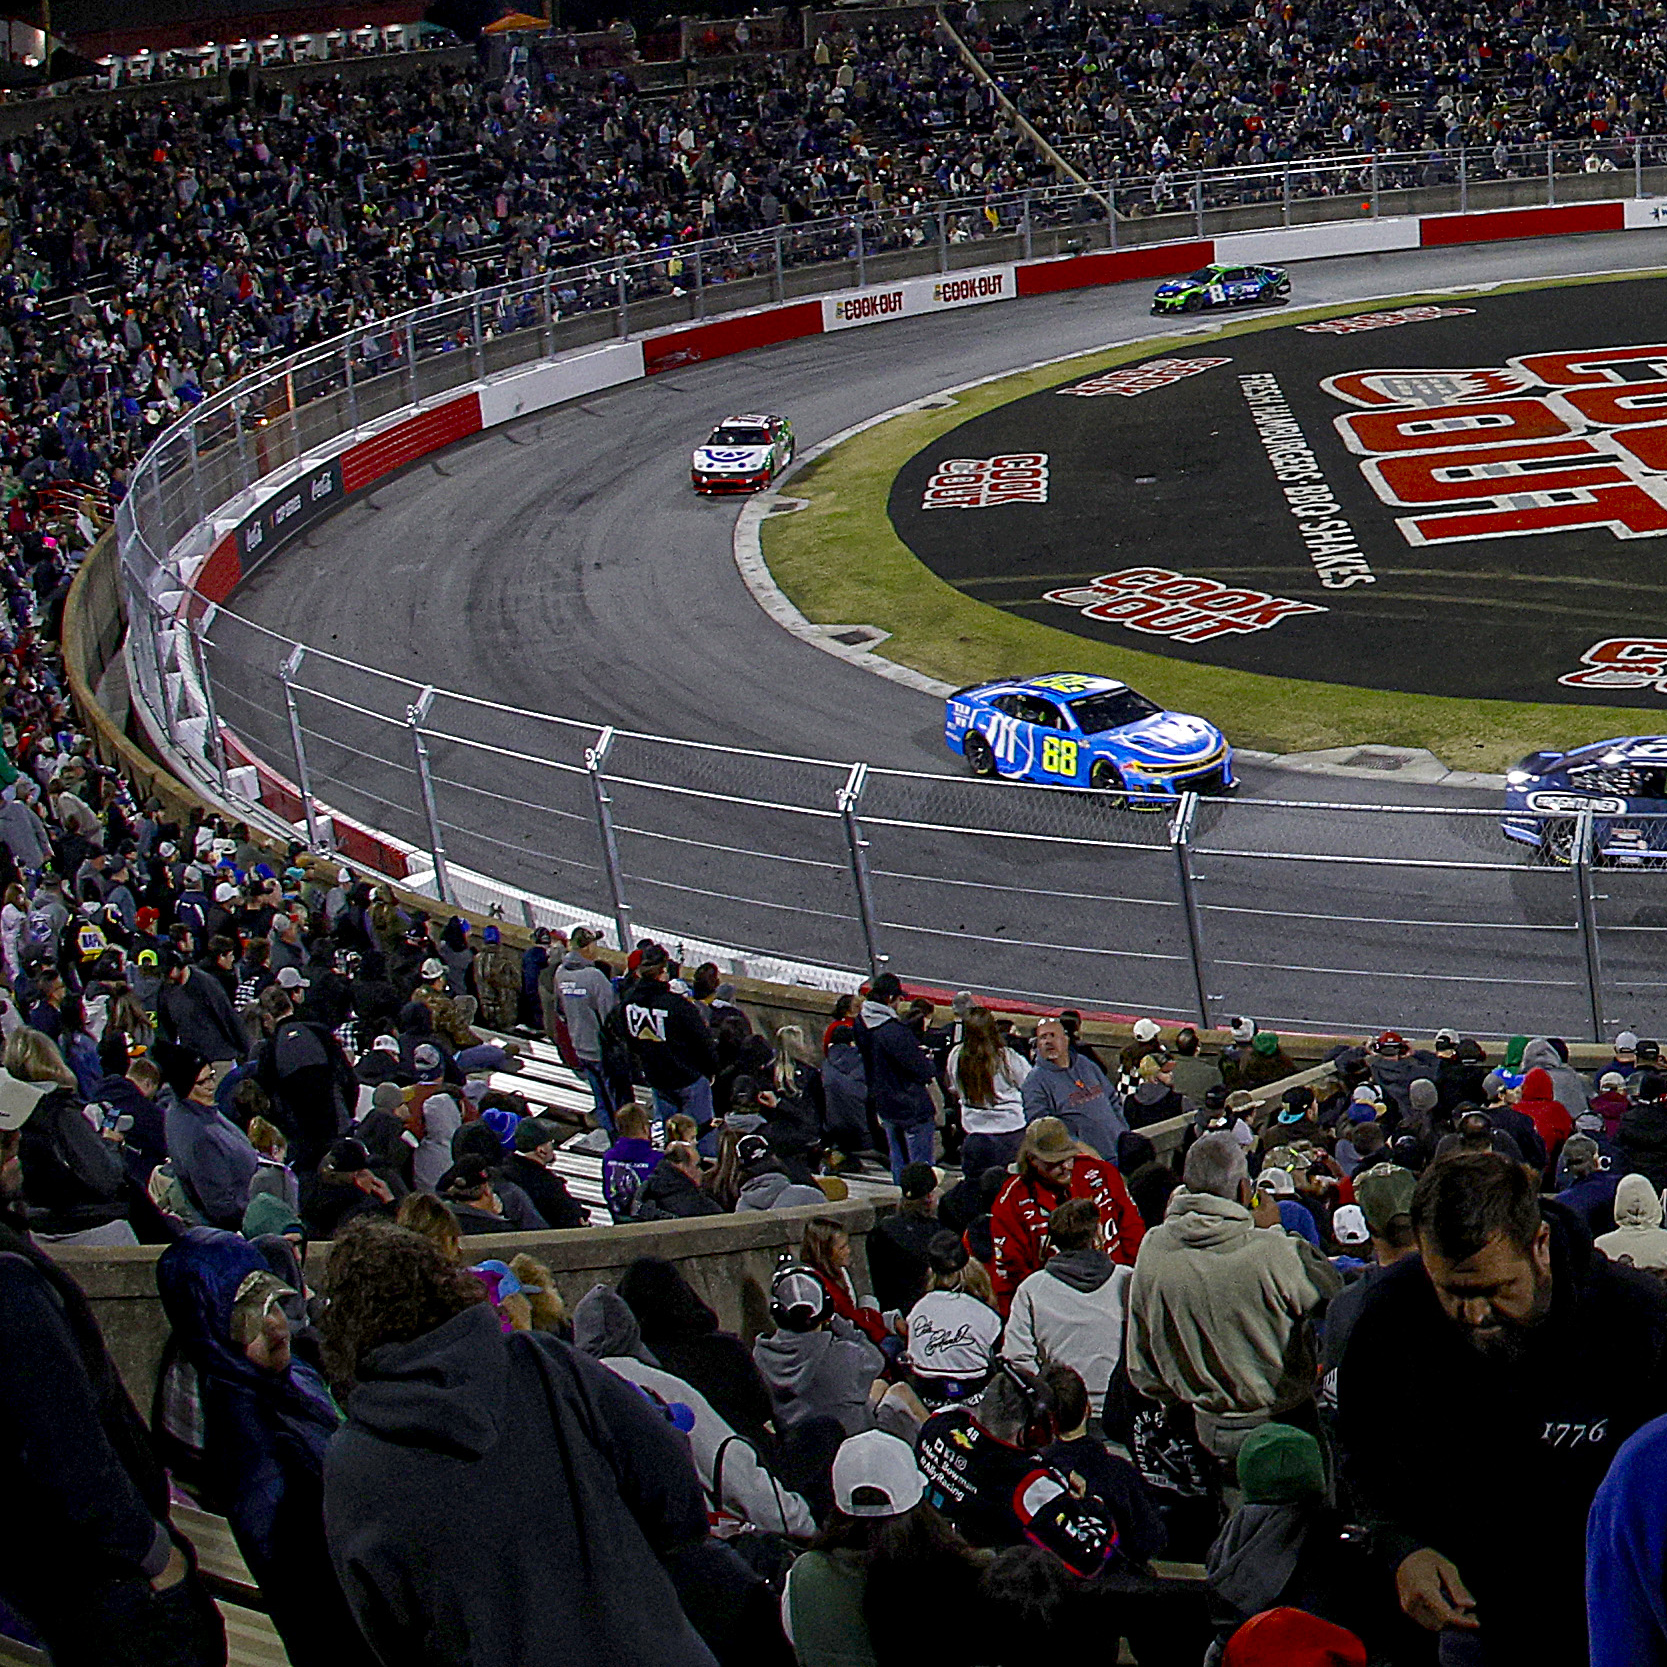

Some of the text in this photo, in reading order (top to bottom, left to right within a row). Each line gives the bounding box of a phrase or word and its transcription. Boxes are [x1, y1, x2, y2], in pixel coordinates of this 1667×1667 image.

[1237, 371, 1281, 408] FRESH
[1252, 402, 1319, 484] HAMBURGERS
[1282, 482, 1342, 520] BBQ
[1299, 520, 1377, 590] SHAKES
[1080, 596, 1261, 644] OUT
[1090, 566, 1330, 633] COOK
[1041, 735, 1079, 778] 88
[625, 1002, 669, 1042] CAT
[965, 1425, 980, 1442] 48
[1541, 1417, 1609, 1449] 1776
